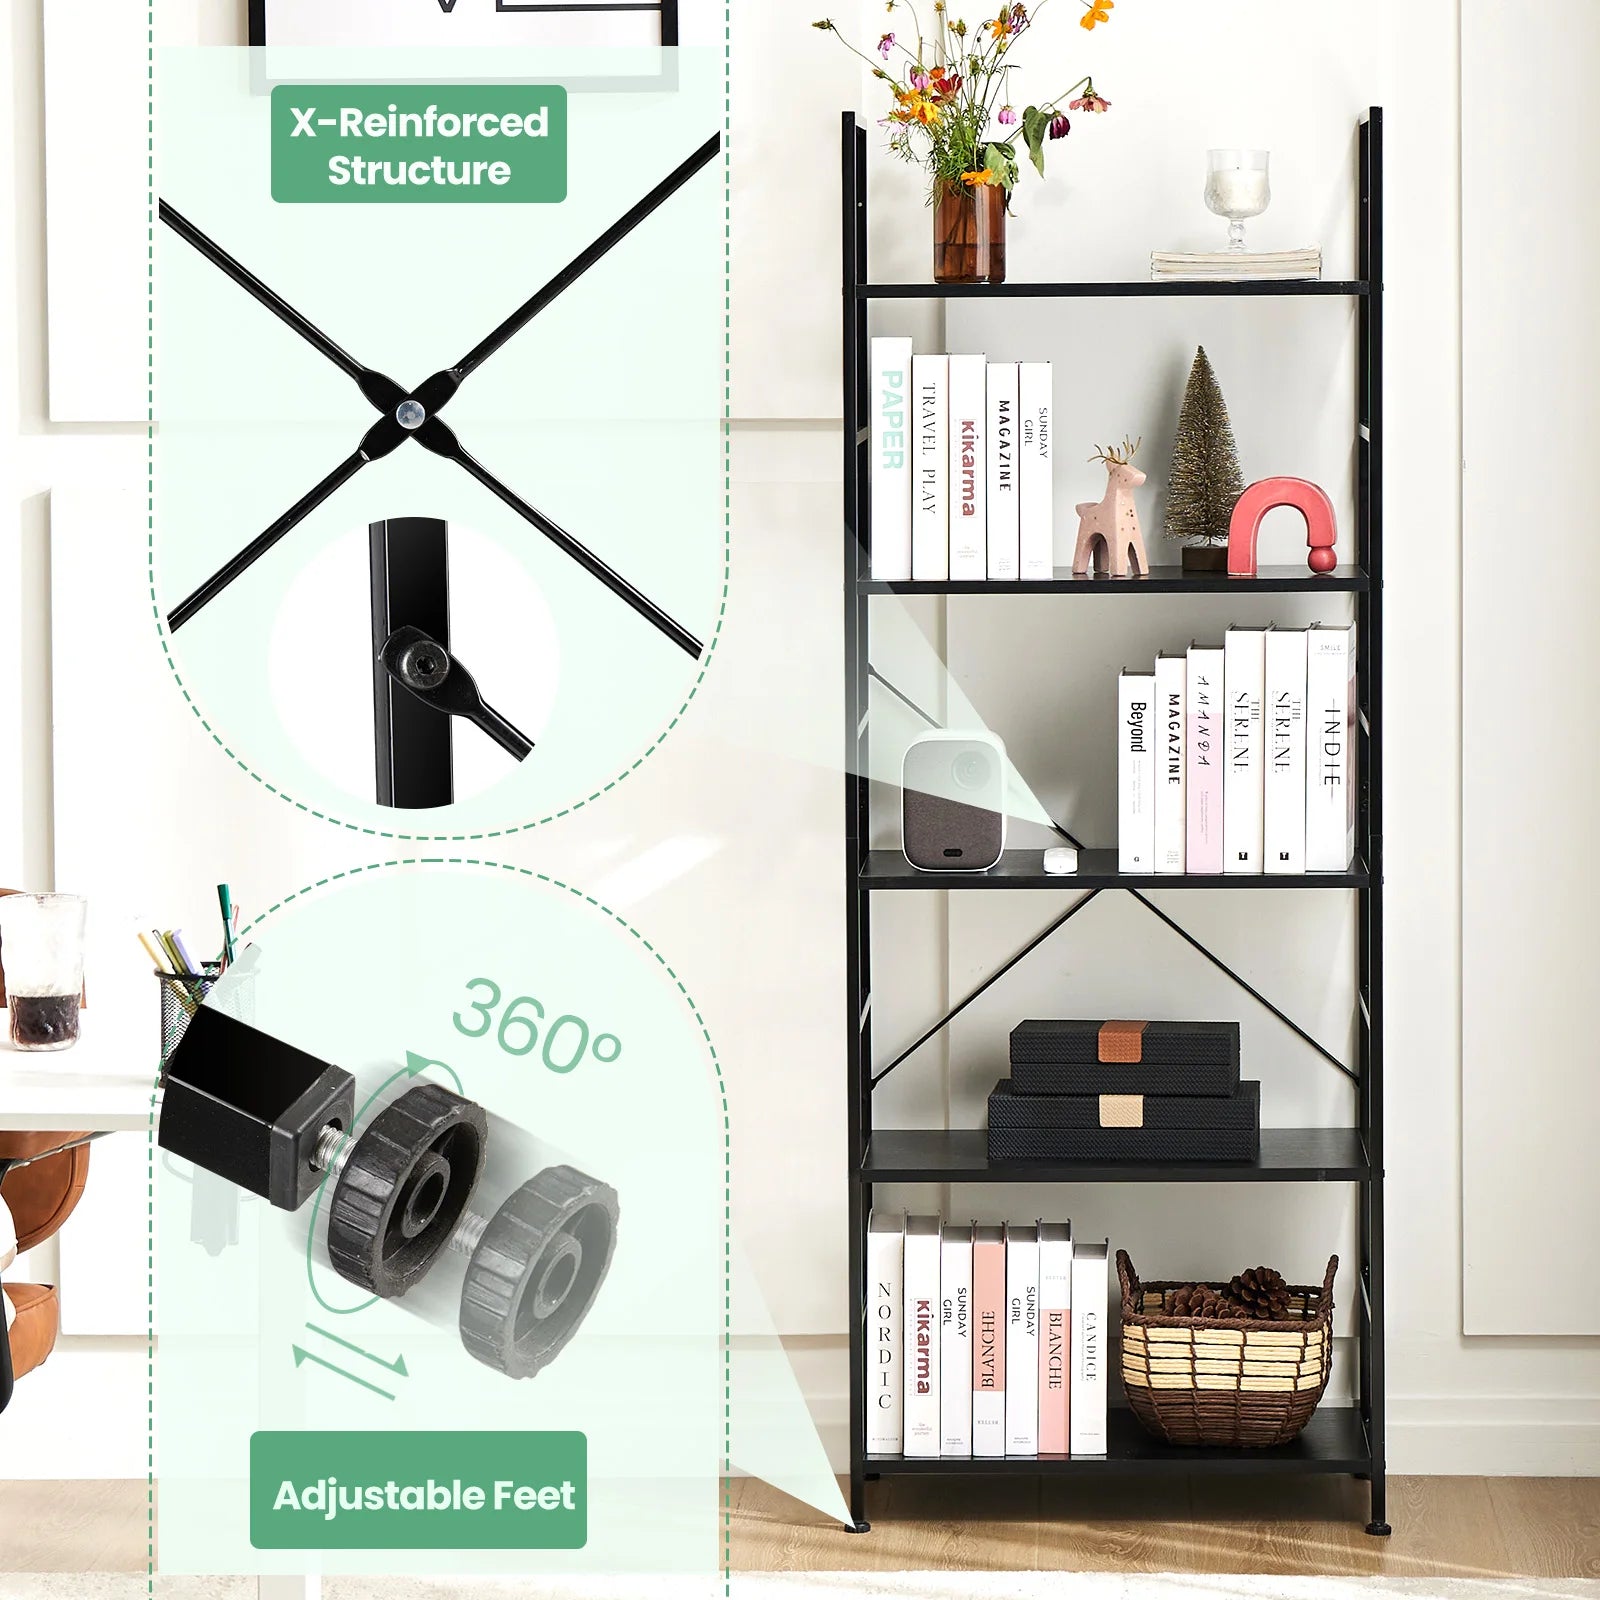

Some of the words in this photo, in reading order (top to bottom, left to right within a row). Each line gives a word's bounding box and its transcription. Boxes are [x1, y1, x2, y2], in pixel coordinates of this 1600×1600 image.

[882, 370, 903, 469] PAPER
[923, 383, 936, 455] TRAVEL
[999, 401, 1011, 491] MAGAZINE
[1025, 420, 1034, 446] GIRL
[1039, 408, 1049, 458] SUNDAY
[923, 470, 936, 514] PLAY
[1127, 702, 1146, 752] Beyond
[1168, 694, 1180, 784] MAGAZINE
[1198, 676, 1210, 765] AMANDA
[1232, 692, 1249, 773] SERENE
[1273, 691, 1290, 773] SERENE
[1325, 710, 1340, 785] INDIE
[879, 1283, 891, 1408] NORDIC
[943, 1299, 952, 1325] GIRL
[958, 1288, 967, 1337] SUNDAY
[1012, 1298, 1021, 1324] GIRL
[1027, 1287, 1036, 1336] SUNDAY
[1086, 1313, 1096, 1380] CANDICE
[982, 1312, 994, 1387] BLANCHE
[1049, 1313, 1062, 1389] BLANCHE
